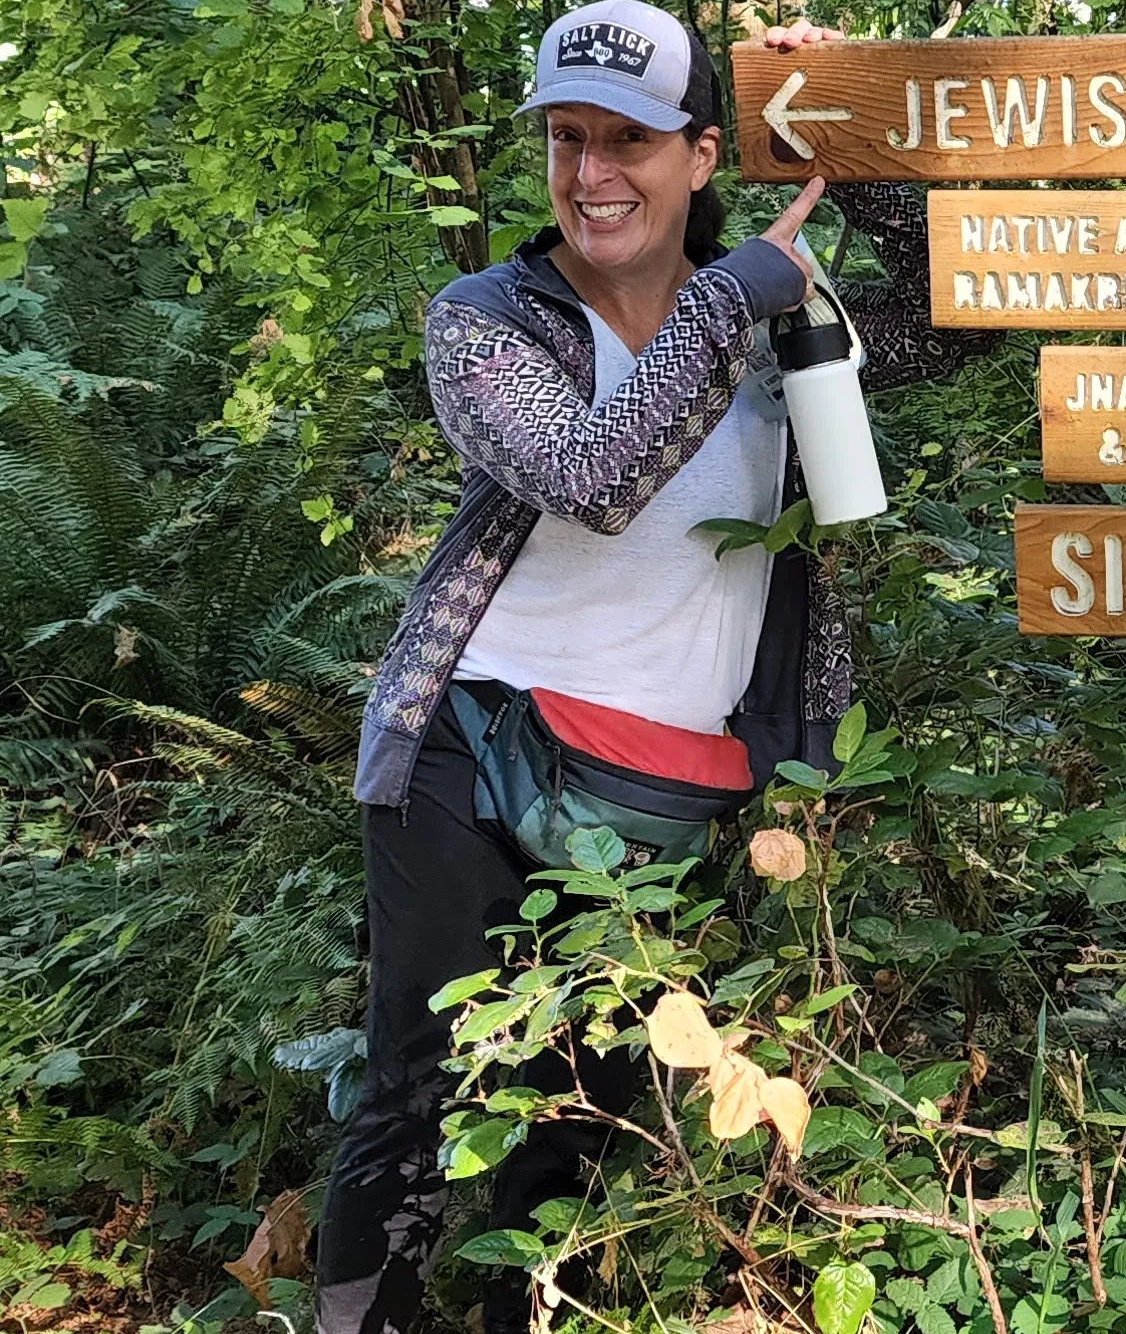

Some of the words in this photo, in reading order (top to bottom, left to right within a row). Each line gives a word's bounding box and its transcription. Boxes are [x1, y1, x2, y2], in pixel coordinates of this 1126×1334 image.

[562, 25, 600, 47] SALT
[607, 26, 650, 56] LICK
[618, 52, 642, 67] 1967
[961, 214, 1100, 256] NATIVE
[1098, 428, 1126, 466] &
